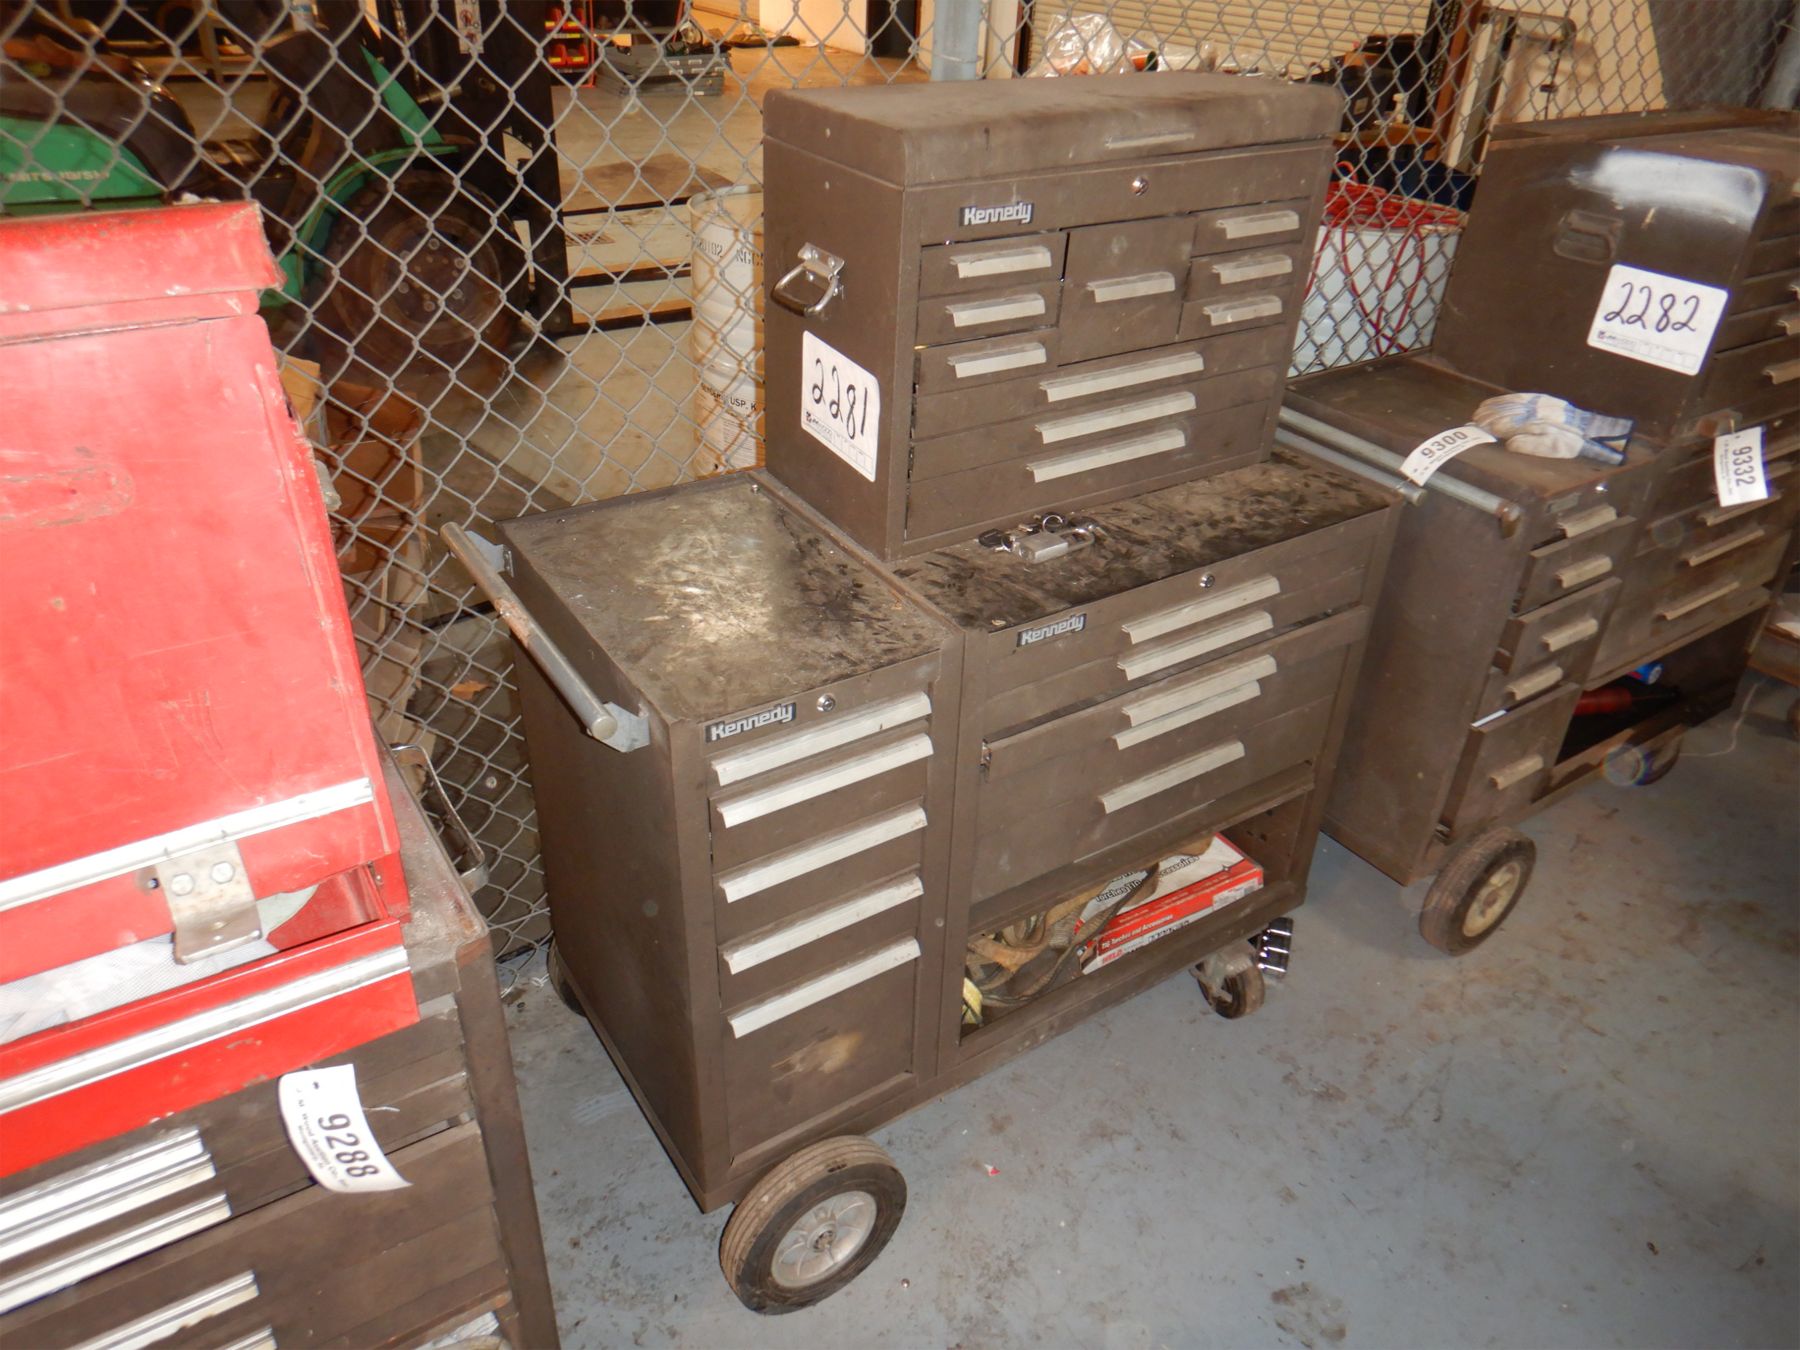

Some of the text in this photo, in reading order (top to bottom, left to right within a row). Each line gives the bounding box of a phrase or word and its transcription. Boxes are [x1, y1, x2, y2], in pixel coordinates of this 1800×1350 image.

[964, 202, 1032, 226] Kennedy
[1603, 281, 1701, 333] 2282
[811, 357, 868, 441] 2281
[1420, 431, 1469, 459] 9300
[1732, 446, 1757, 487] 9332
[1021, 615, 1085, 646] Kennedy
[710, 704, 793, 741] Kennedy
[317, 1113, 380, 1178] 9288
